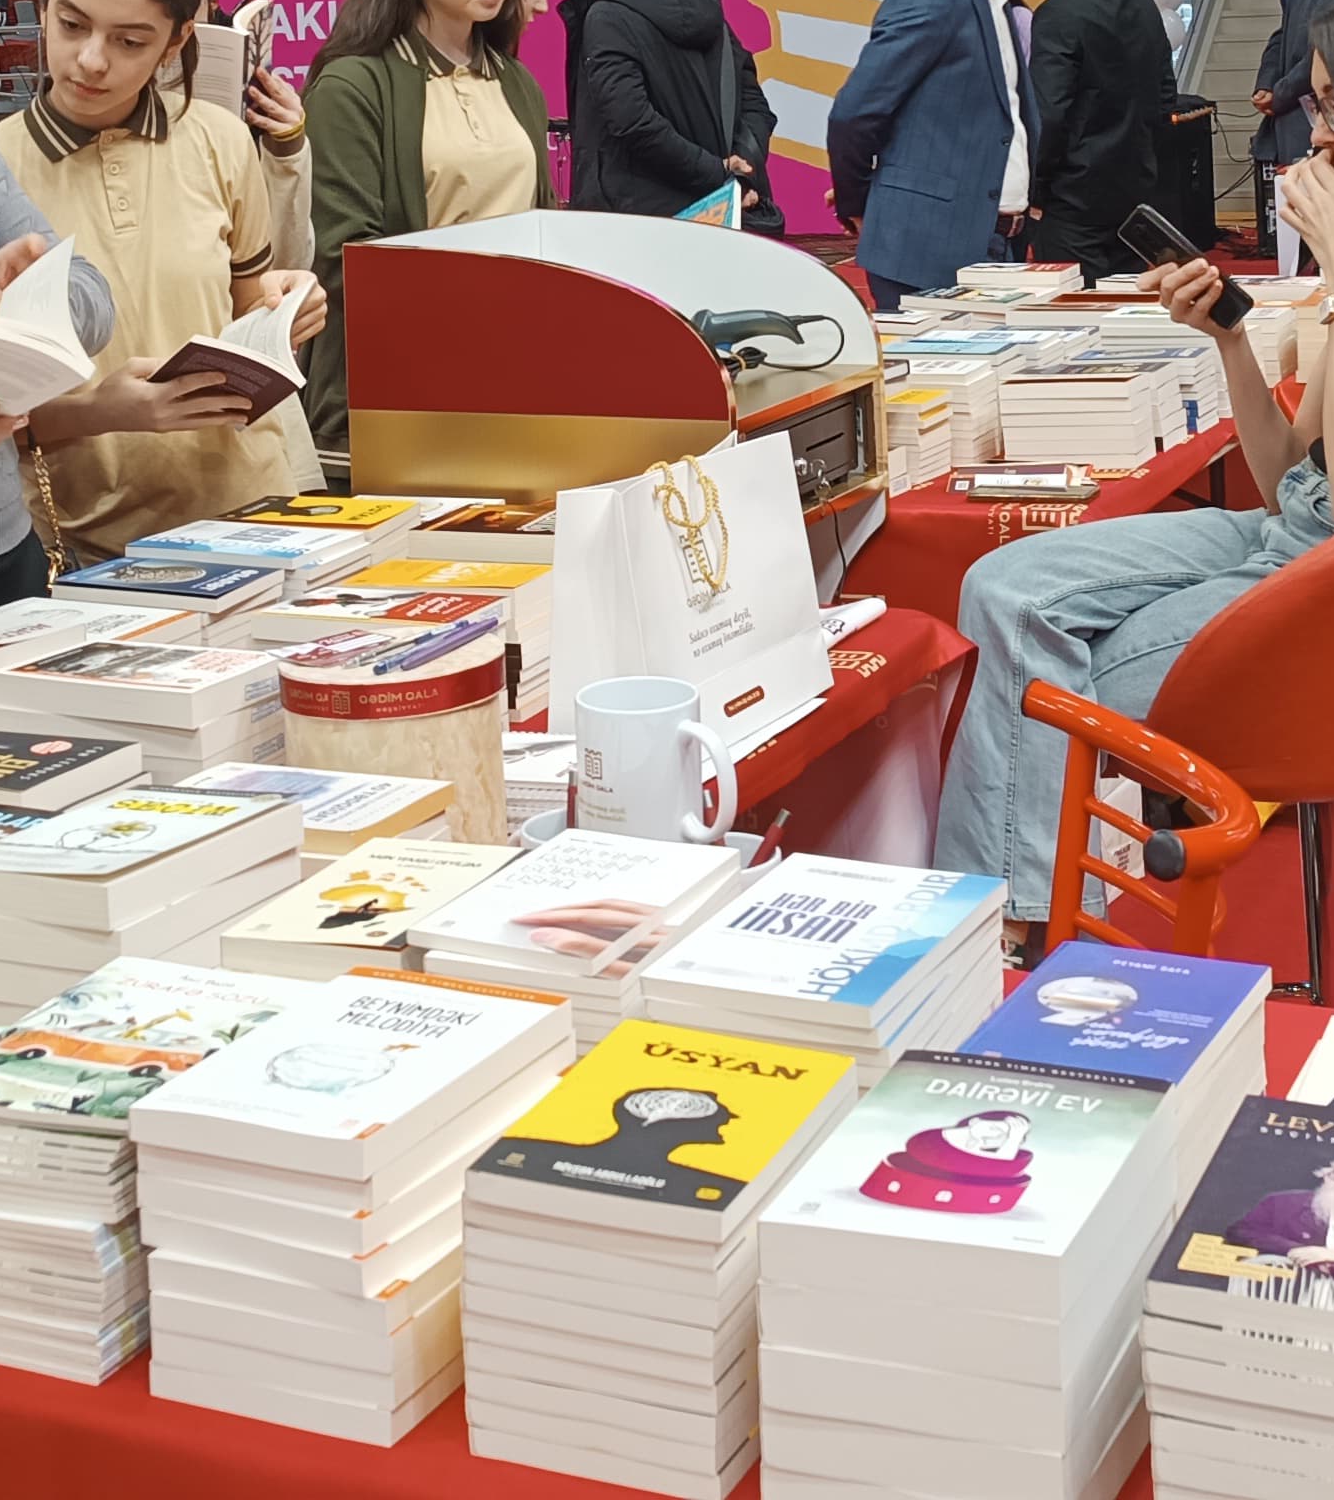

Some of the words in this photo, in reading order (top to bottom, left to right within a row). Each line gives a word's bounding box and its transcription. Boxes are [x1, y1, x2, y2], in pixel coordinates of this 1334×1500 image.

[358, 692, 403, 706] QƏDİM
[405, 687, 440, 701] QALA
[770, 892, 827, 914] HƏR
[826, 900, 878, 920] BİR
[726, 901, 858, 944] İNSAN
[643, 1041, 809, 1081] ÜSYAN
[1054, 1094, 1105, 1115] EV
